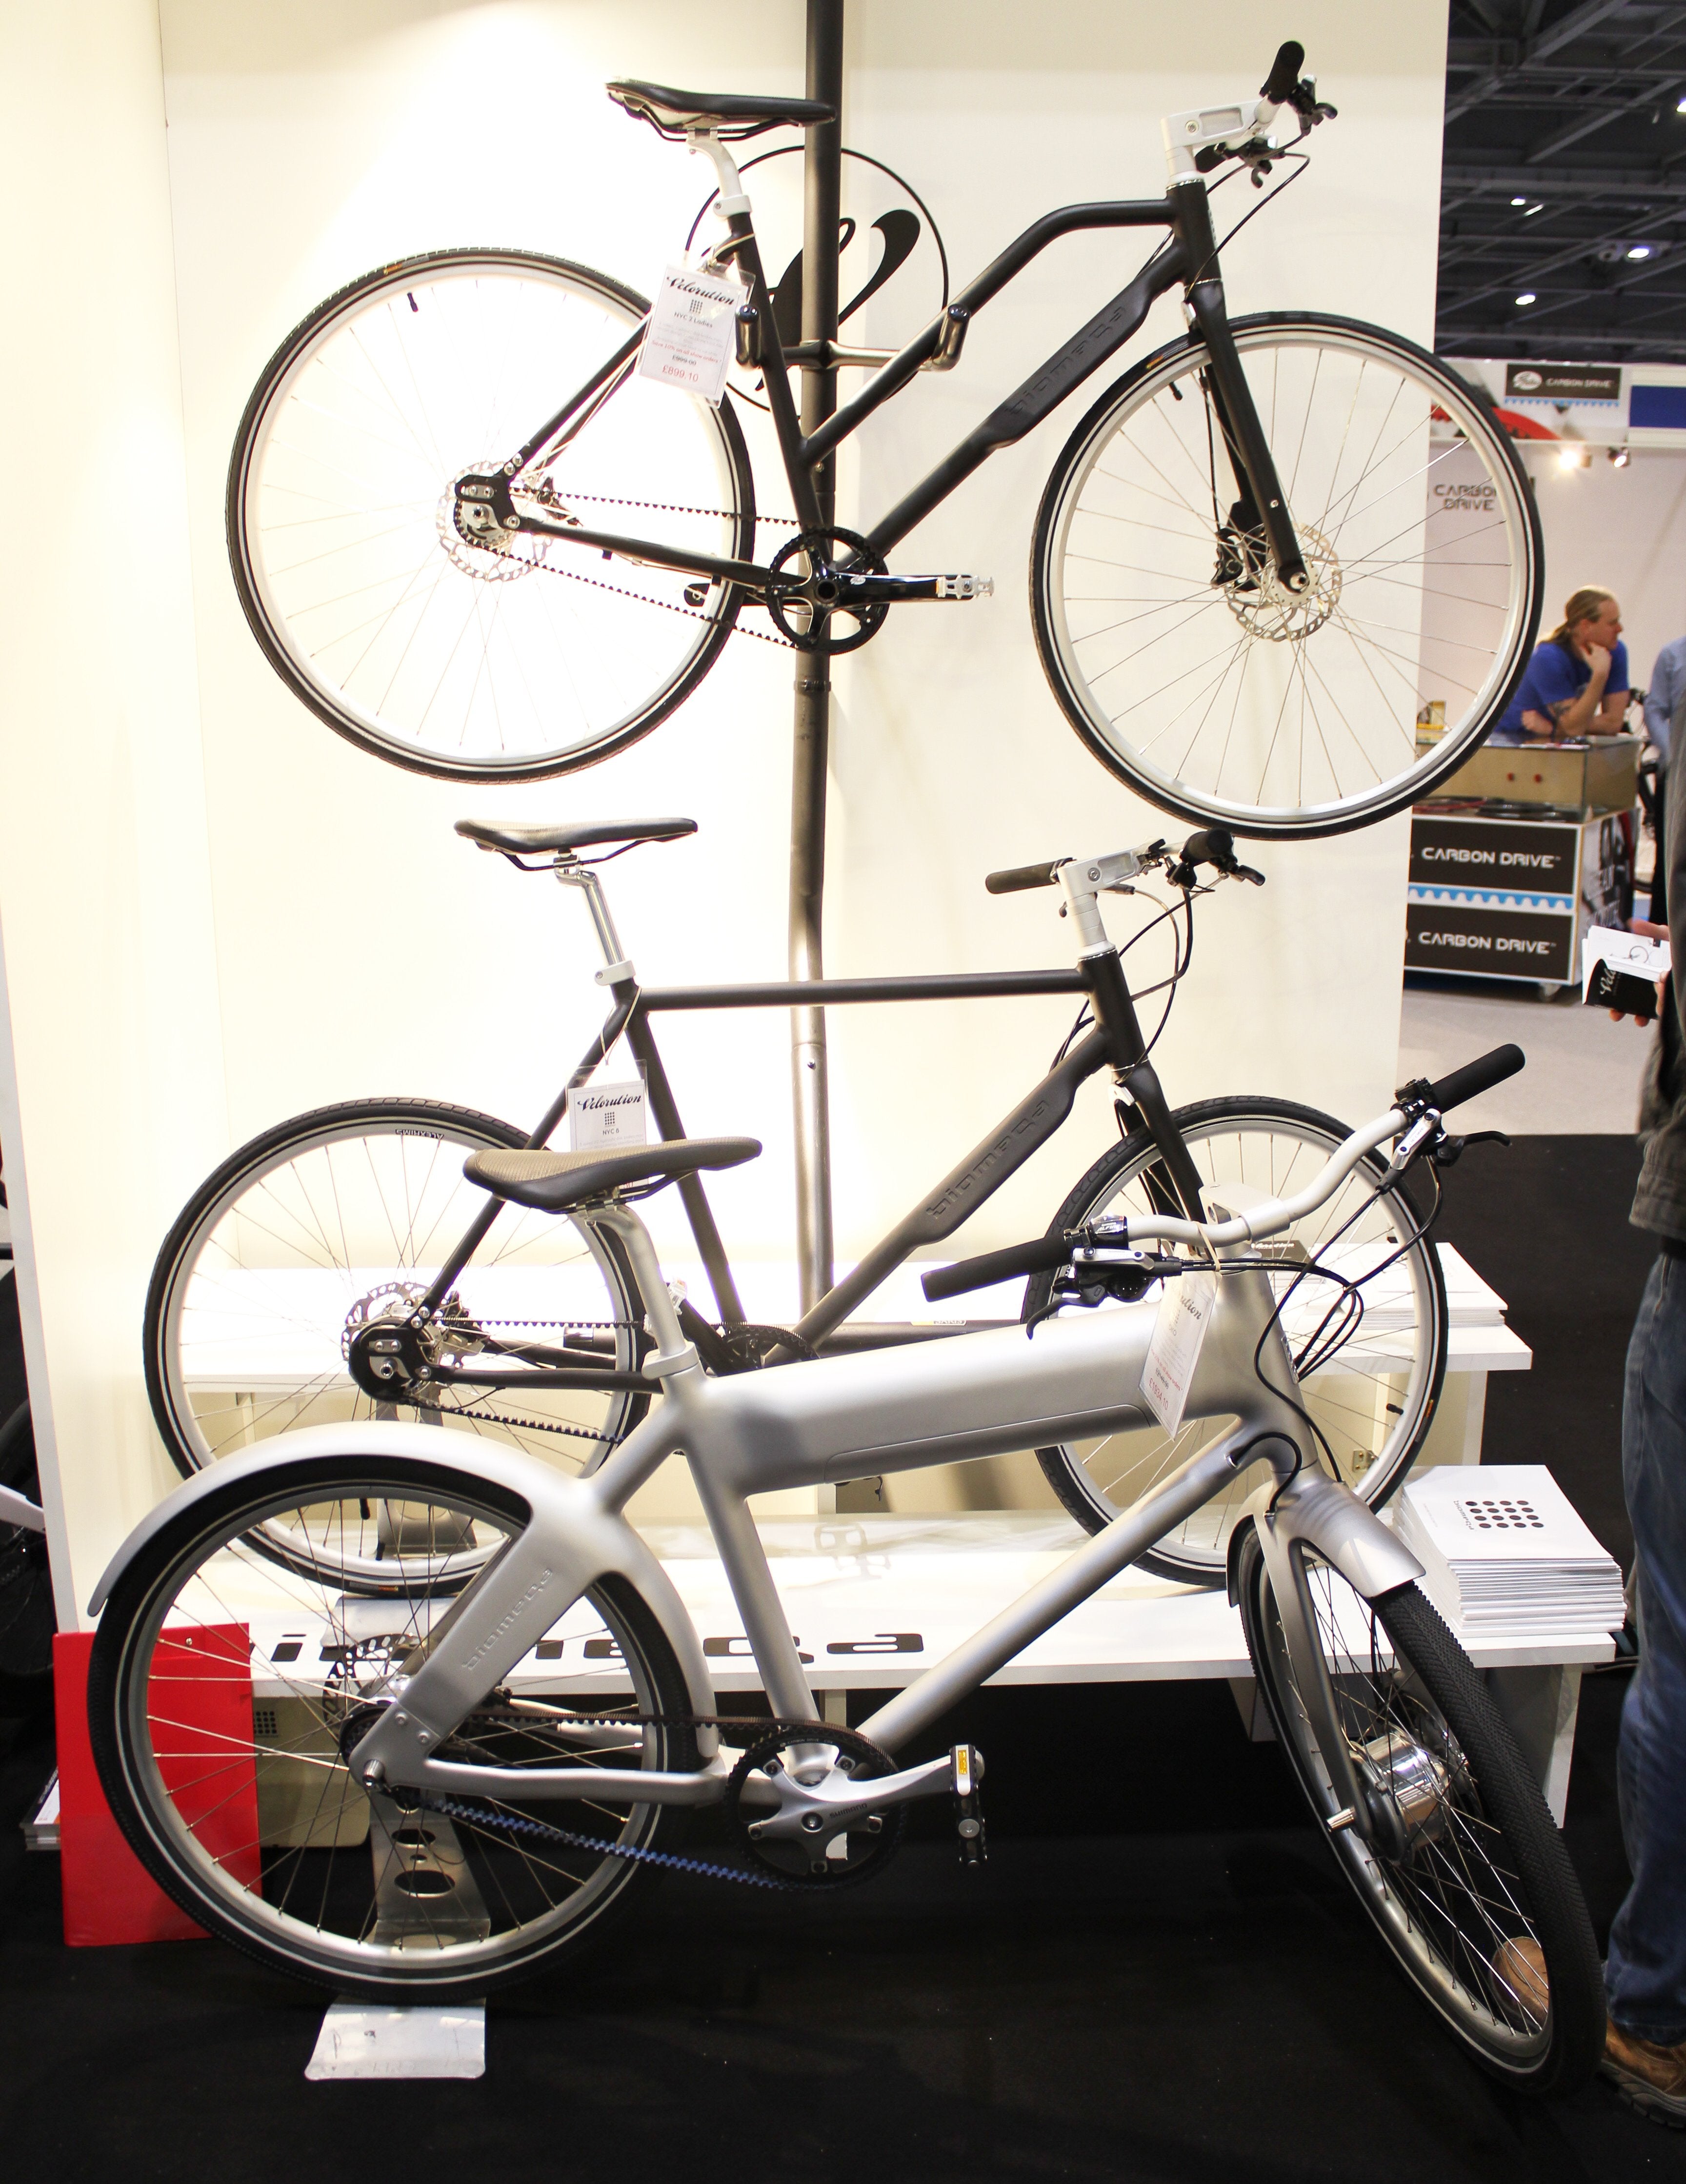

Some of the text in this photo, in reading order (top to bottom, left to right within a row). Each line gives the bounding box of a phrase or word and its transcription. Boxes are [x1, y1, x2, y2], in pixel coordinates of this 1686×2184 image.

[666, 276, 735, 305] Velorution
[674, 311, 687, 320] NYC
[694, 319, 713, 328] Ladies
[662, 364, 699, 382] £899.10
[1444, 498, 1494, 511] DRIVE
[1421, 847, 1496, 865] CARBON
[1418, 931, 1492, 950] CARBON
[577, 1094, 641, 1111] Velorution
